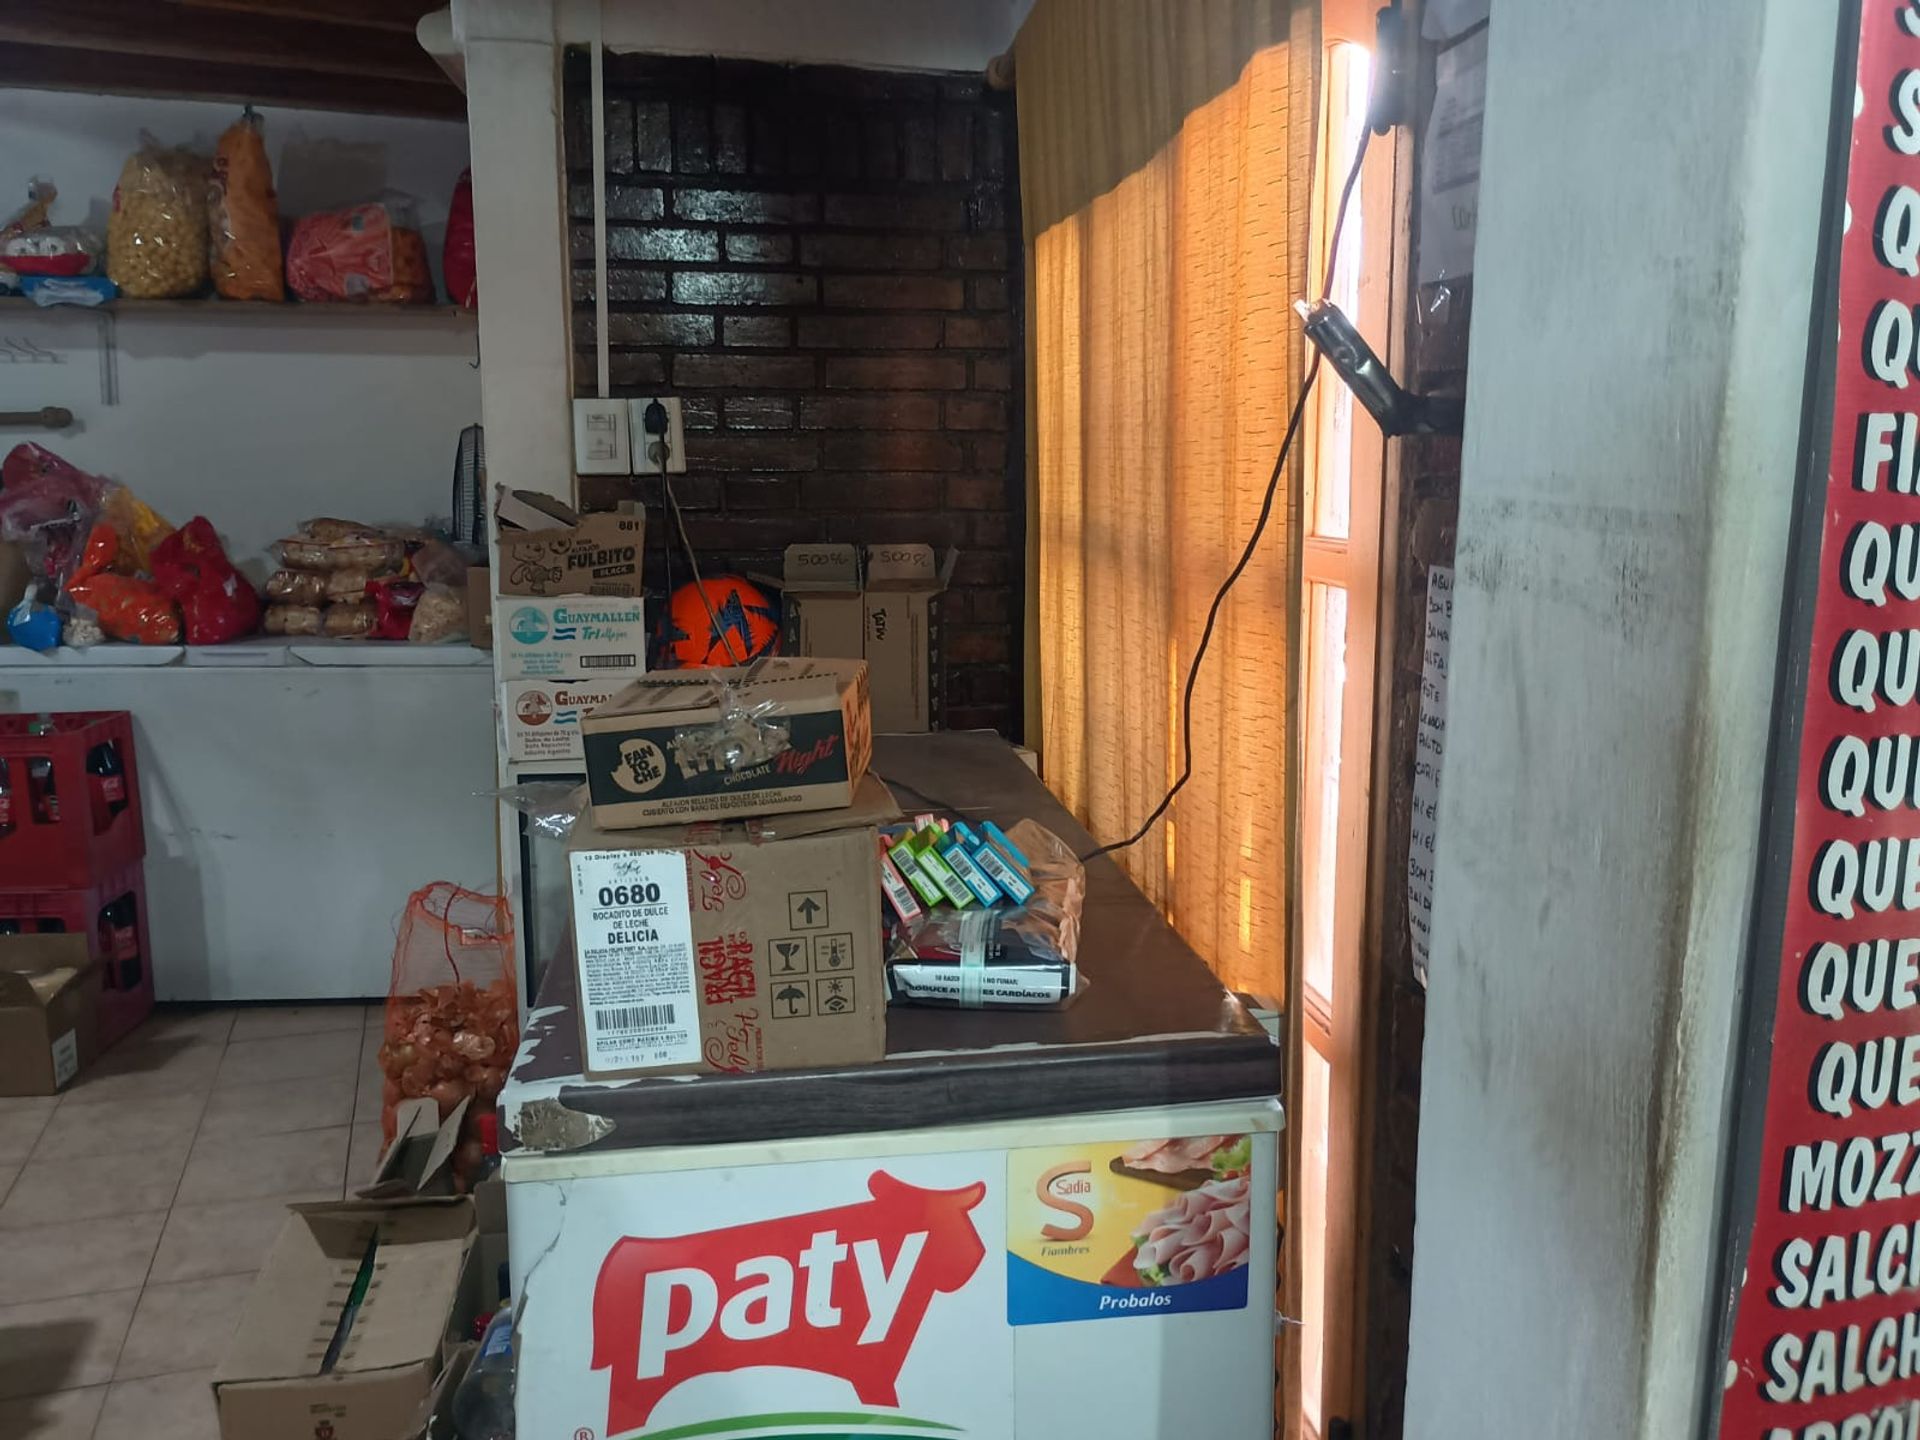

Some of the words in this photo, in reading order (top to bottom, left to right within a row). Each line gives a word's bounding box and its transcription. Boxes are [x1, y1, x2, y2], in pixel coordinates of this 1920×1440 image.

[1871, 299, 1920, 389] Q
[1862, 412, 1920, 495] FI
[567, 546, 636, 570] FULBITO
[553, 607, 641, 624] GUAYMALLEN
[554, 690, 612, 706] GUAYMA
[624, 745, 655, 764] FAN
[723, 765, 771, 786] CHOCOLATE
[775, 735, 839, 775] Night
[633, 759, 650, 775] TO
[633, 766, 662, 785] CHE
[1818, 837, 1920, 920] QUE
[598, 883, 660, 907] 0680
[592, 909, 632, 921] BOCADITO
[632, 908, 642, 918] DE
[644, 906, 669, 917] DULCE
[613, 921, 624, 930] DE
[625, 919, 649, 929] LECHE
[607, 929, 659, 945] DELICIA
[1808, 939, 1920, 1021] QUE
[1818, 1034, 1920, 1118] QUE
[1055, 1179, 1091, 1195] Sadia
[1040, 1244, 1091, 1258] Fiambres
[637, 1229, 930, 1381] paty
[1099, 1292, 1173, 1311] Probalos
